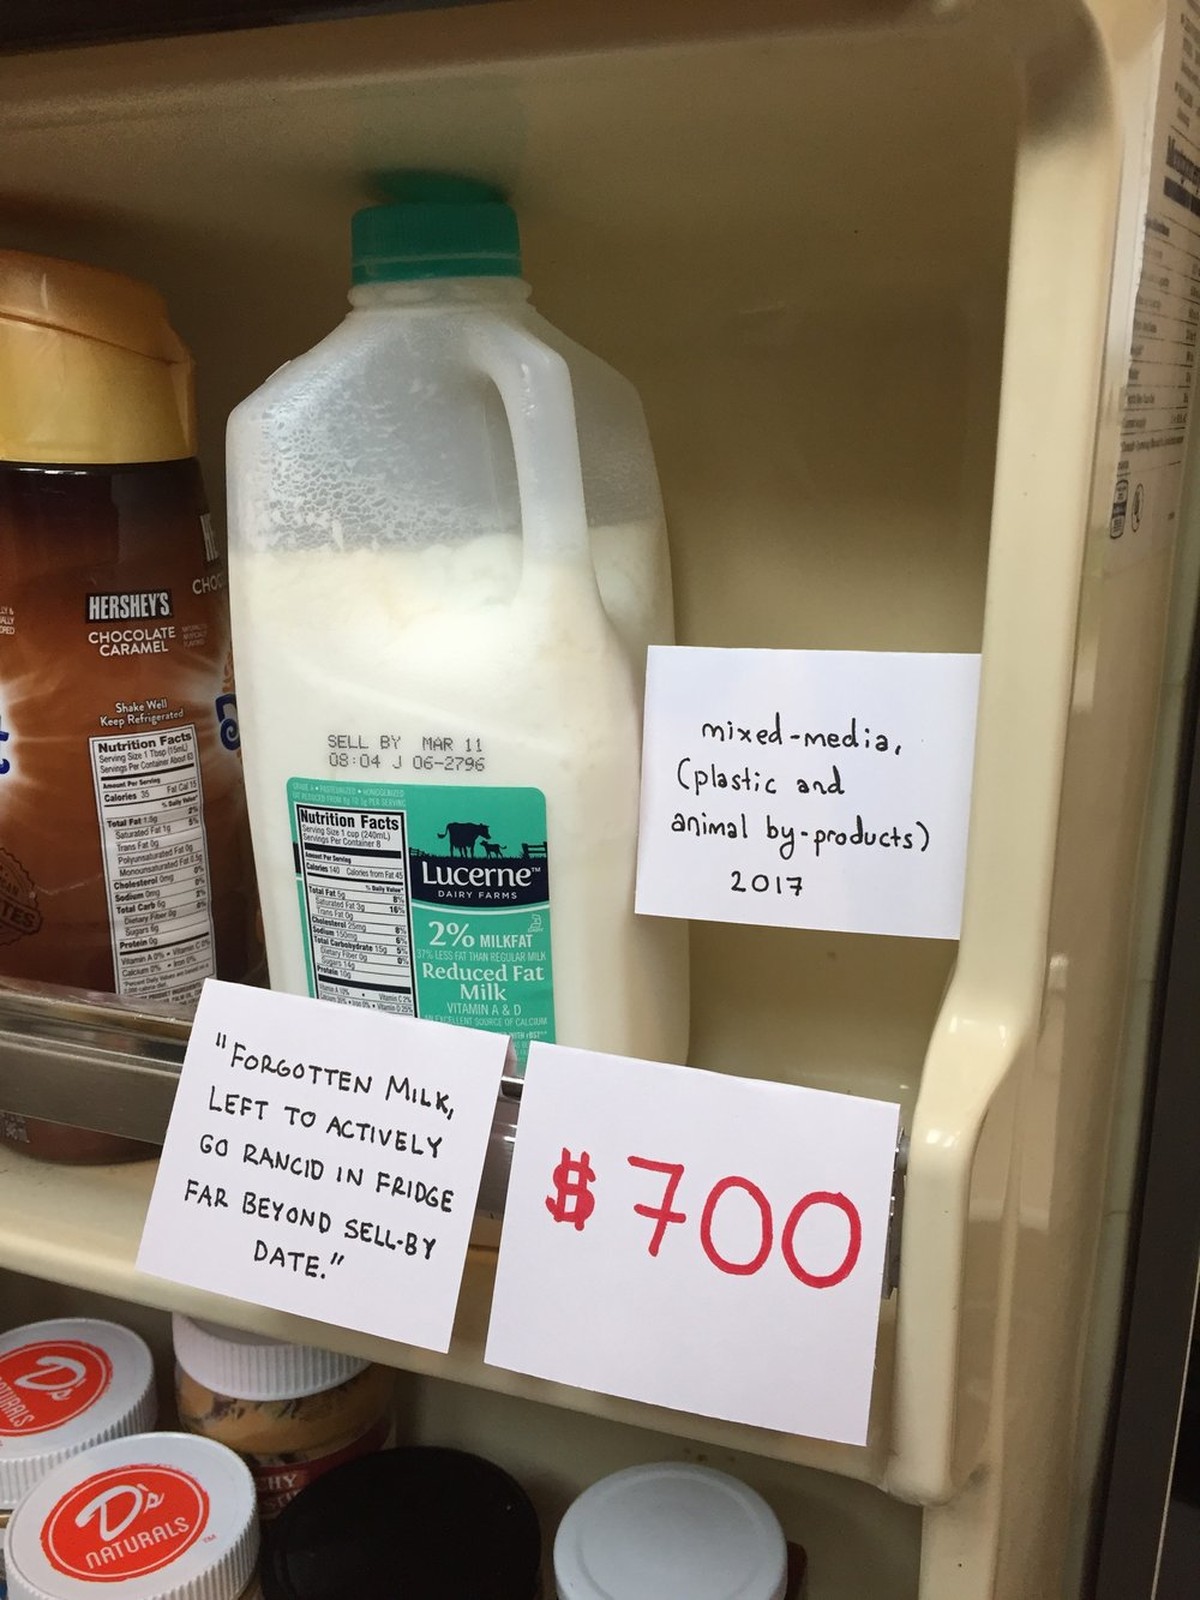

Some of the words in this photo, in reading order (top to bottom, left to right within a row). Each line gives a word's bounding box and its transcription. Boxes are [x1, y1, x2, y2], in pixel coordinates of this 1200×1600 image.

[89, 592, 169, 620] HERSHEY'S
[88, 626, 176, 644] CHOCOLATE
[100, 641, 169, 656] CARAMEL
[115, 701, 145, 714] Shake
[147, 699, 168, 710] Well
[100, 716, 125, 727] Keep
[127, 709, 184, 726] Refrigerated
[701, 711, 902, 756] mixed-media,
[98, 740, 156, 753] Nutrition
[159, 732, 192, 746] Facts
[328, 734, 369, 749] SELL
[380, 735, 401, 749] BY
[422, 737, 453, 751] MAR
[465, 738, 482, 752] 11
[99, 753, 126, 763] Serving
[128, 751, 142, 760] Size
[150, 748, 166, 758] Tbsp
[168, 745, 188, 755] (15mL)
[329, 753, 380, 768] 08:04
[392, 755, 402, 769] J
[413, 755, 485, 771] 06-2796
[100, 763, 127, 774] Servings
[129, 762, 139, 771] Per
[141, 758, 169, 769] Container
[170, 754, 186, 764] About
[677, 757, 778, 796] (plastic
[796, 765, 846, 795] and
[104, 793, 137, 802] Calories
[167, 785, 177, 793] Fat
[180, 783, 188, 792] Cal
[107, 819, 127, 828] Total
[301, 809, 355, 828] Nutrition
[360, 815, 399, 830] Facts
[116, 829, 149, 840] Saturated
[151, 826, 161, 834] Fat
[163, 825, 171, 833] 1g
[302, 824, 325, 835] Serving
[326, 827, 340, 836] Size
[361, 829, 390, 841] (240mL)
[303, 833, 329, 844] Servings
[331, 836, 341, 845] Per
[343, 838, 374, 848] Container
[376, 840, 381, 848] 8
[670, 812, 749, 839] animal
[765, 814, 930, 860] by-products)
[117, 842, 136, 852] Trans
[138, 841, 149, 849] Fat
[118, 849, 173, 864] Polyunsaturated
[174, 846, 184, 854] Fat
[120, 860, 178, 876] Monounsaturated
[179, 857, 189, 866] Fat
[333, 856, 351, 864] Serving
[306, 863, 328, 873] Calories
[329, 865, 340, 873] 140
[346, 868, 369, 877] Calories
[370, 869, 384, 878] from
[385, 871, 394, 879] Fat
[422, 860, 532, 887] Lucerne
[113, 876, 158, 890] Cholesterol
[730, 870, 803, 896] 2017
[115, 893, 144, 902] Sodium
[309, 886, 324, 895] Total
[325, 888, 336, 897] Fat
[337, 891, 346, 900] 5g
[438, 890, 473, 899] DAIRY
[478, 891, 517, 900] FARMS
[116, 906, 135, 914] Total
[137, 902, 155, 911] Carb
[315, 896, 344, 908] Saturated
[345, 901, 355, 909] Fat
[356, 902, 365, 912] 3g
[389, 906, 405, 914] 16%
[317, 906, 333, 916] Trans
[335, 910, 344, 918] Fat
[345, 911, 353, 921] 0g
[124, 916, 149, 925] Dietary
[150, 912, 167, 920] Fiber
[312, 916, 346, 928] Cholesterol
[348, 921, 366, 932] 25mg
[125, 927, 149, 936] Sugars
[313, 926, 335, 936] Sodium
[336, 930, 357, 941] 150mg
[428, 921, 475, 948] 2%
[480, 934, 533, 948] MILKFAT
[120, 940, 147, 948] Protein
[314, 936, 329, 945] Total
[330, 939, 373, 951] Carbohydrate
[375, 945, 387, 954] 15g
[320, 946, 340, 956] Dietary
[342, 949, 358, 959] Fiber
[121, 956, 147, 965] Vitamin
[172, 944, 195, 955] Vitamin
[321, 956, 342, 966] Sugars
[417, 949, 433, 959] 37%
[434, 950, 453, 960] LESS
[454, 951, 467, 960] FAT
[469, 952, 488, 961] THAN
[490, 952, 525, 962] REGULAR
[527, 951, 546, 961] MILK
[122, 968, 149, 977] Calcium
[317, 965, 338, 975] Protein
[422, 962, 508, 981] Reduced
[513, 965, 545, 981] Fat
[460, 983, 507, 1001] Milk
[377, 1003, 395, 1011] Vitamin
[447, 1003, 489, 1016] VITAMIN
[492, 1004, 499, 1016] A
[502, 1004, 510, 1016] &
[514, 1004, 521, 1016] D
[475, 1017, 502, 1026] SOURCE
[504, 1018, 514, 1026] OF
[515, 1017, 548, 1026] CALCIUM
[208, 1086, 269, 1120] LEFT
[284, 1105, 317, 1128] TO
[326, 1115, 443, 1159] ACTIVELY
[199, 1133, 229, 1158] GO
[242, 1142, 325, 1181] RANCID
[336, 1166, 364, 1187] IN
[375, 1171, 455, 1213] FRIDGE
[184, 1179, 229, 1209] FAR
[242, 1191, 331, 1234] BEYOND
[343, 1218, 437, 1260] SELL-BY
[85, 1516, 190, 1569] NATURALS
